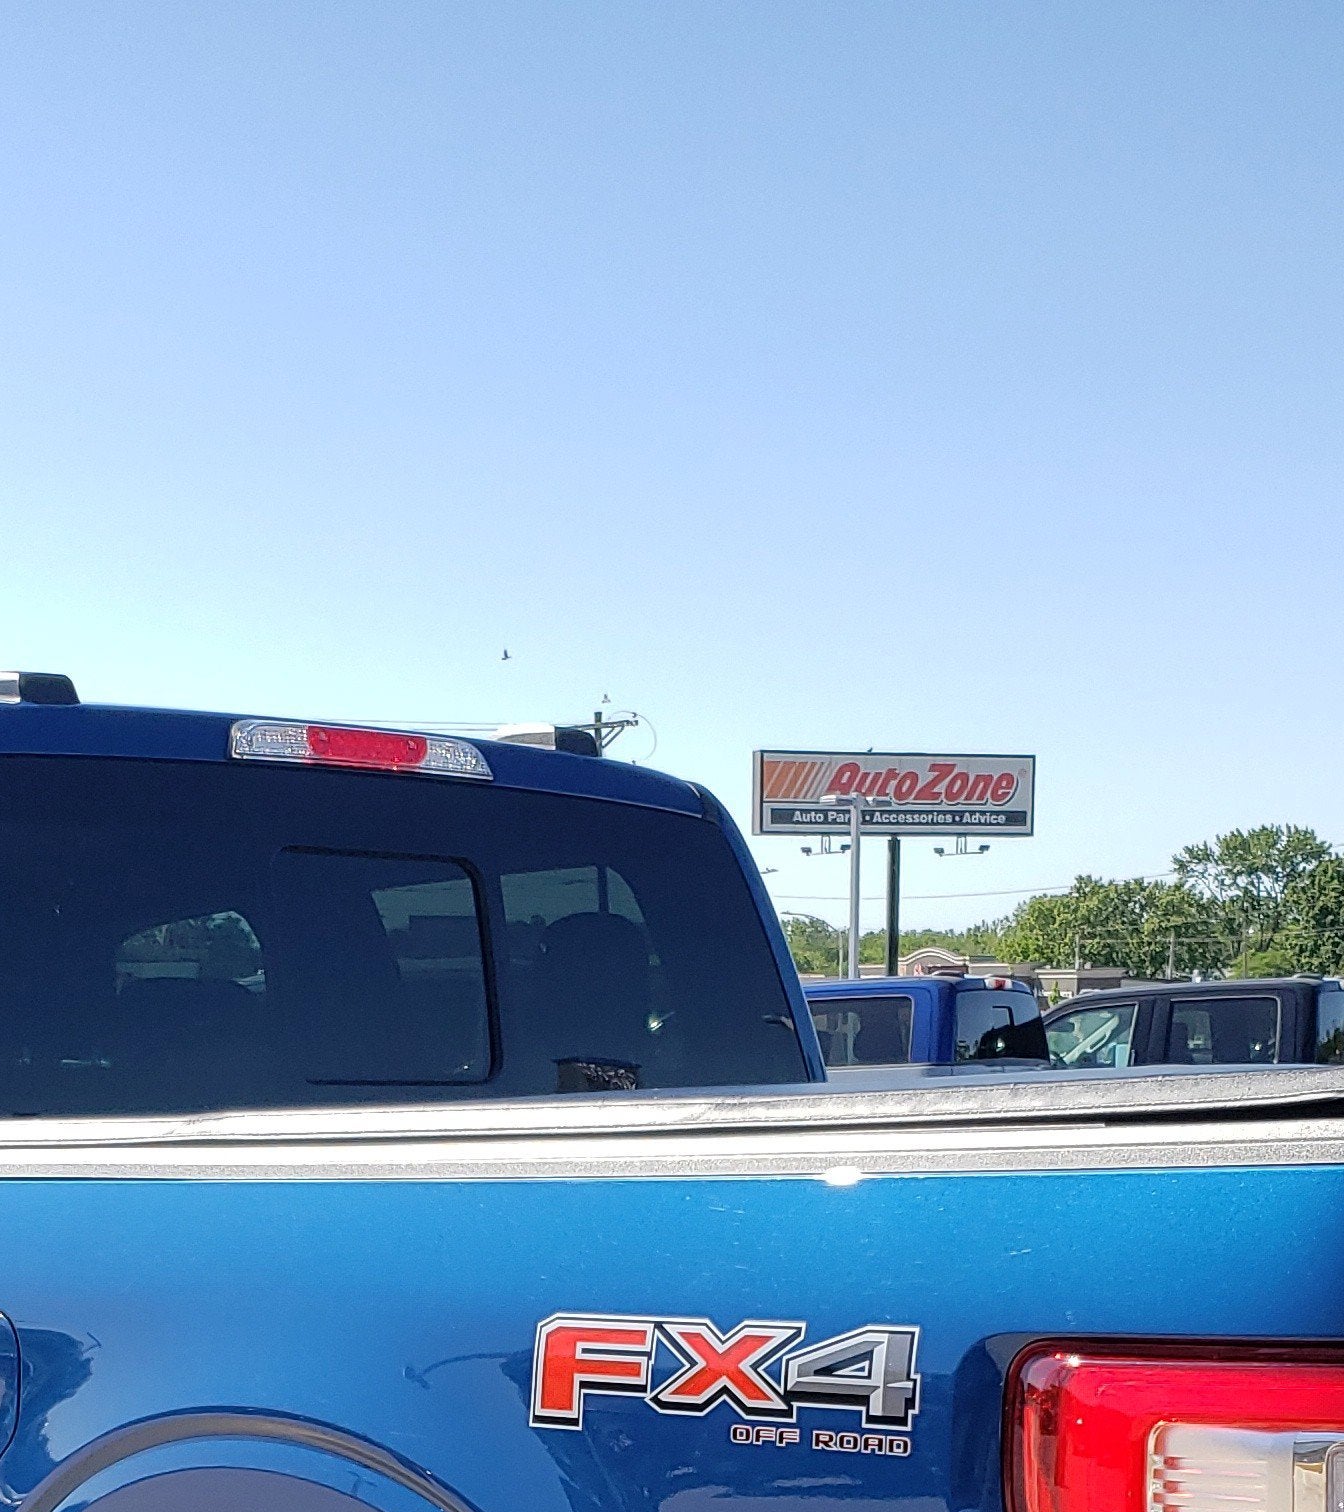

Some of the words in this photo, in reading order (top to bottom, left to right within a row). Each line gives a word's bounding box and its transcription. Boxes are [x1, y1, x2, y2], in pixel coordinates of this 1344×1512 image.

[827, 761, 1018, 805] AutoZone
[792, 810, 824, 824] Auto
[827, 810, 863, 824] Par
[872, 810, 953, 824] Accessories
[963, 810, 1006, 824] Advice
[529, 1312, 921, 1431] FX4
[729, 1423, 800, 1448] OFF
[812, 1429, 912, 1458] ROAD
